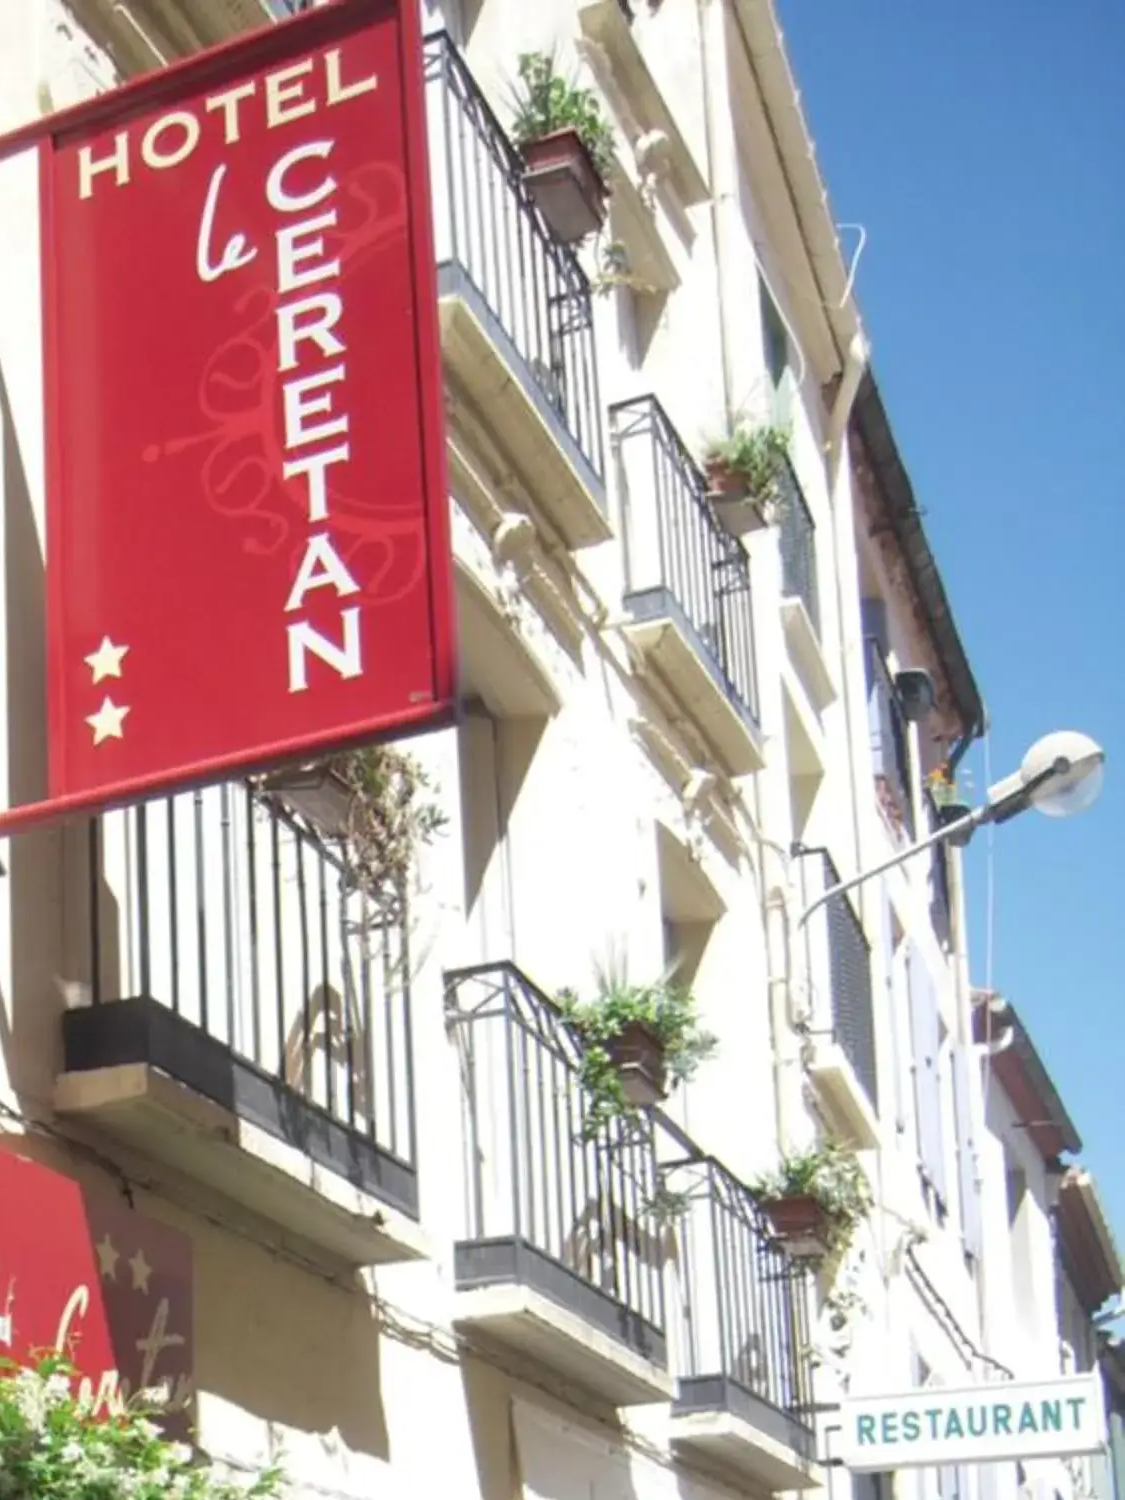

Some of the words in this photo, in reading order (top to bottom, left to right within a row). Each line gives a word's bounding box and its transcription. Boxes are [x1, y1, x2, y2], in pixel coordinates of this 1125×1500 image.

[77, 49, 378, 201] HOTEL
[196, 163, 258, 282] le
[265, 139, 364, 693] CERETAN
[856, 1397, 1086, 1446] RESTAURANT
